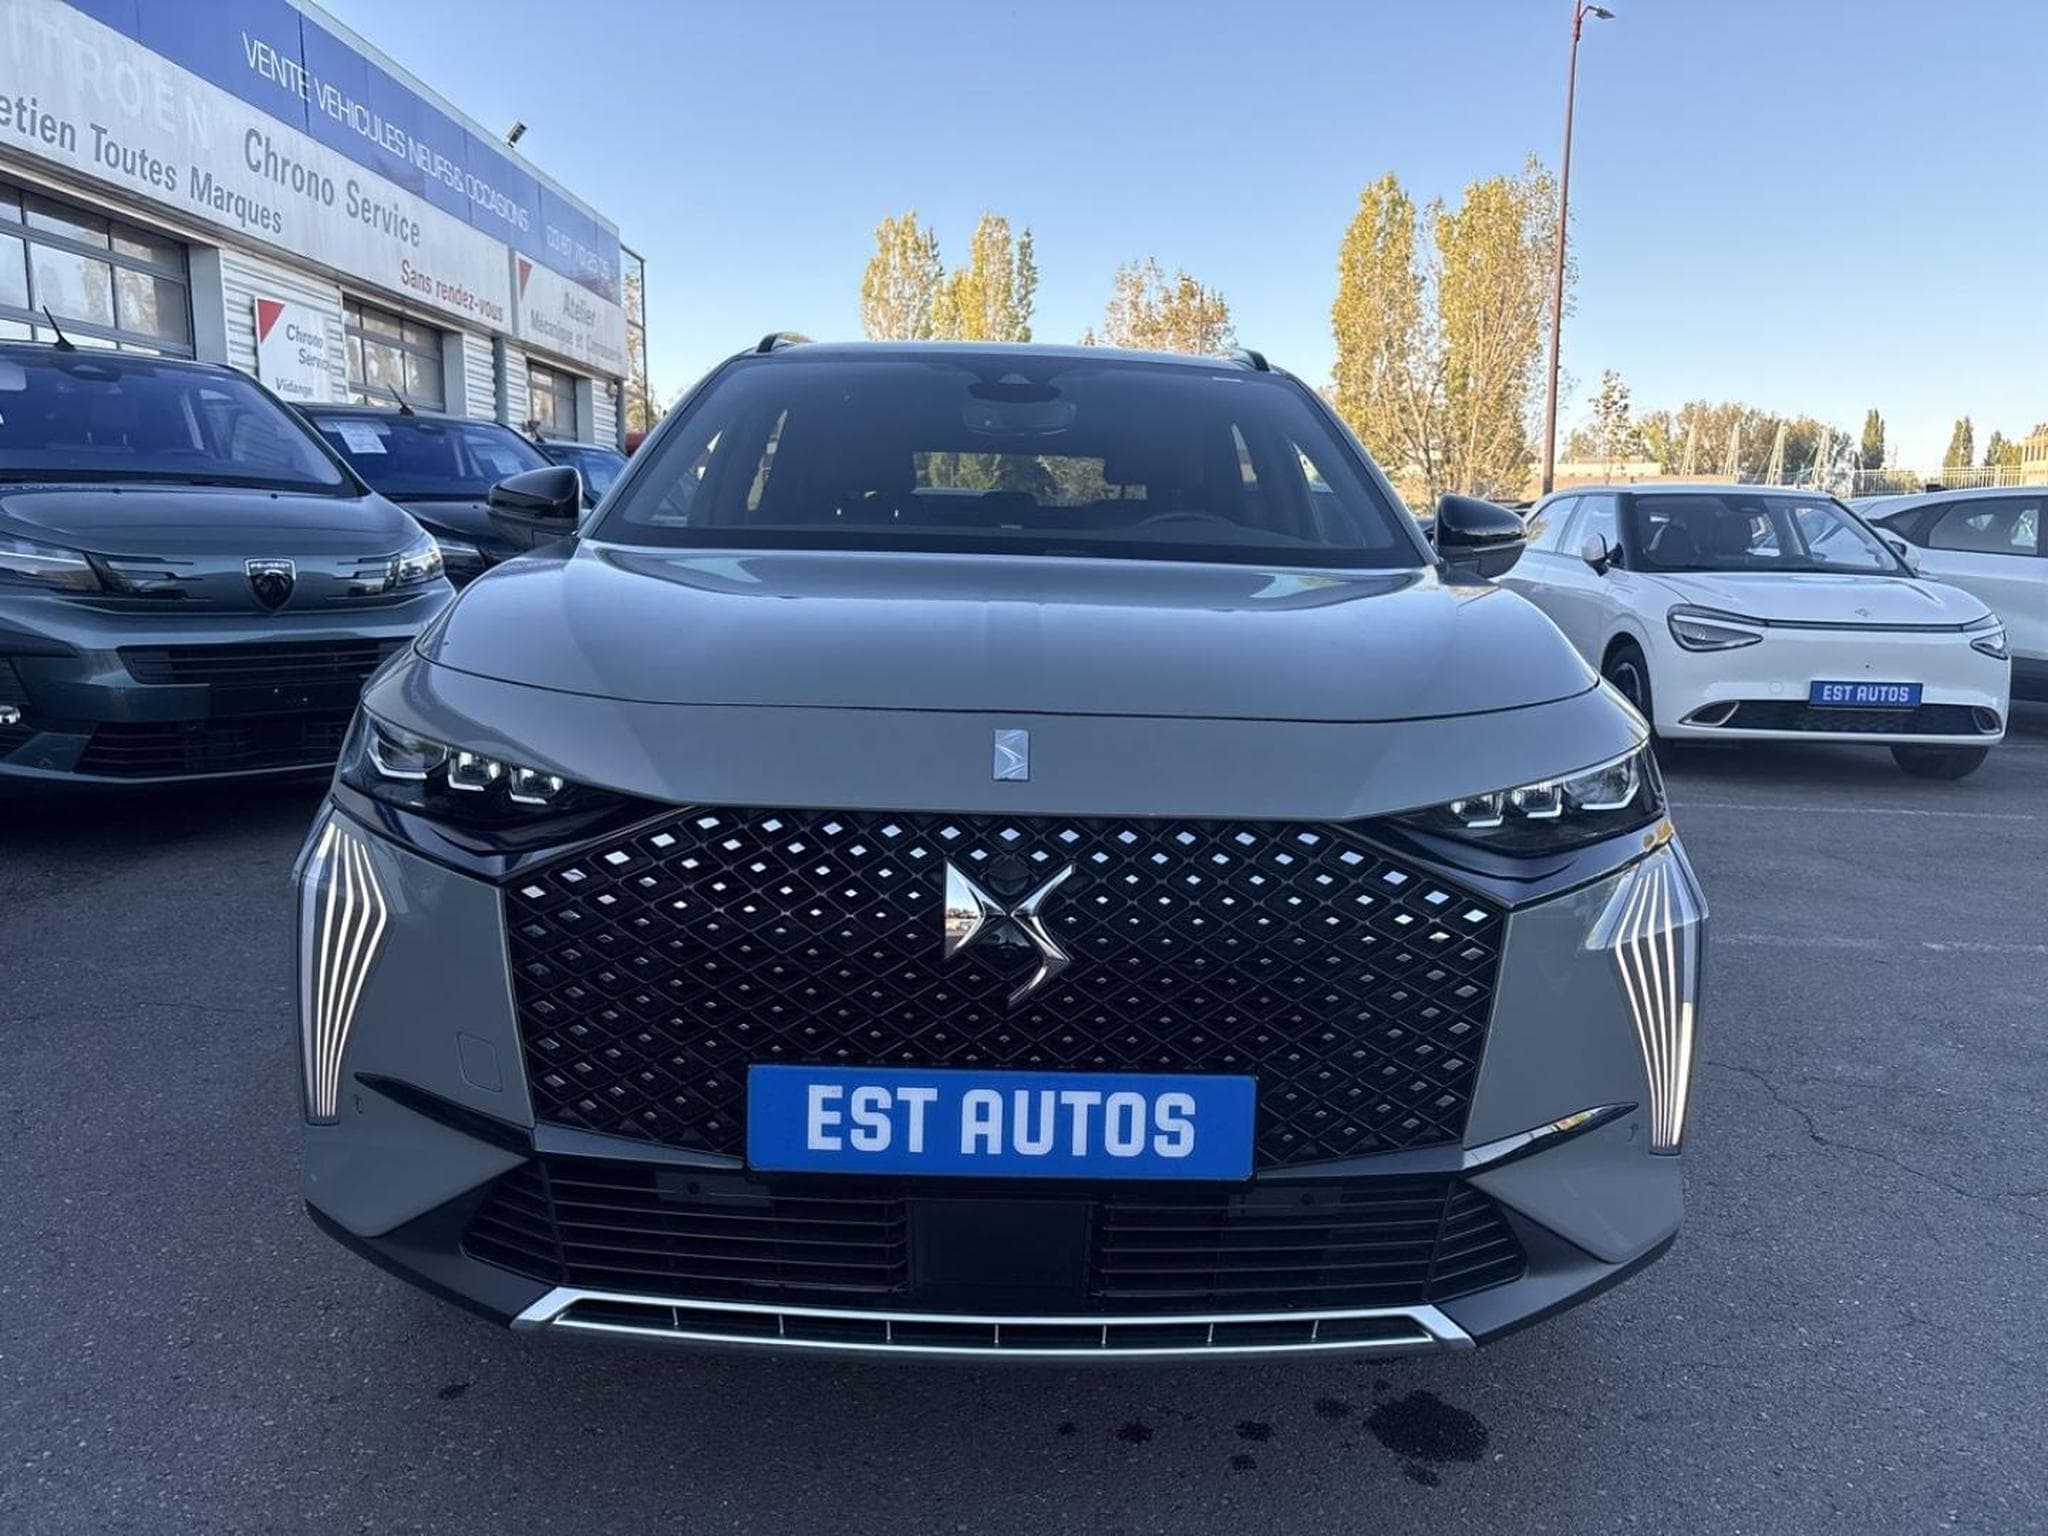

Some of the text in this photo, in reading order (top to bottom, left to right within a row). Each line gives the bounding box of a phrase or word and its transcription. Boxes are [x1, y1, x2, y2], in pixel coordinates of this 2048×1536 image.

[242, 30, 311, 104] VENTE
[314, 77, 407, 159] VEHICULES
[90, 123, 177, 192] Toutes
[190, 166, 283, 235] Marques
[244, 128, 421, 248] Chrono Service
[401, 258, 504, 323] Sans rendez-vous
[1822, 685, 1910, 703] EST AUTOS
[807, 1084, 1197, 1159] EST AUTOS
